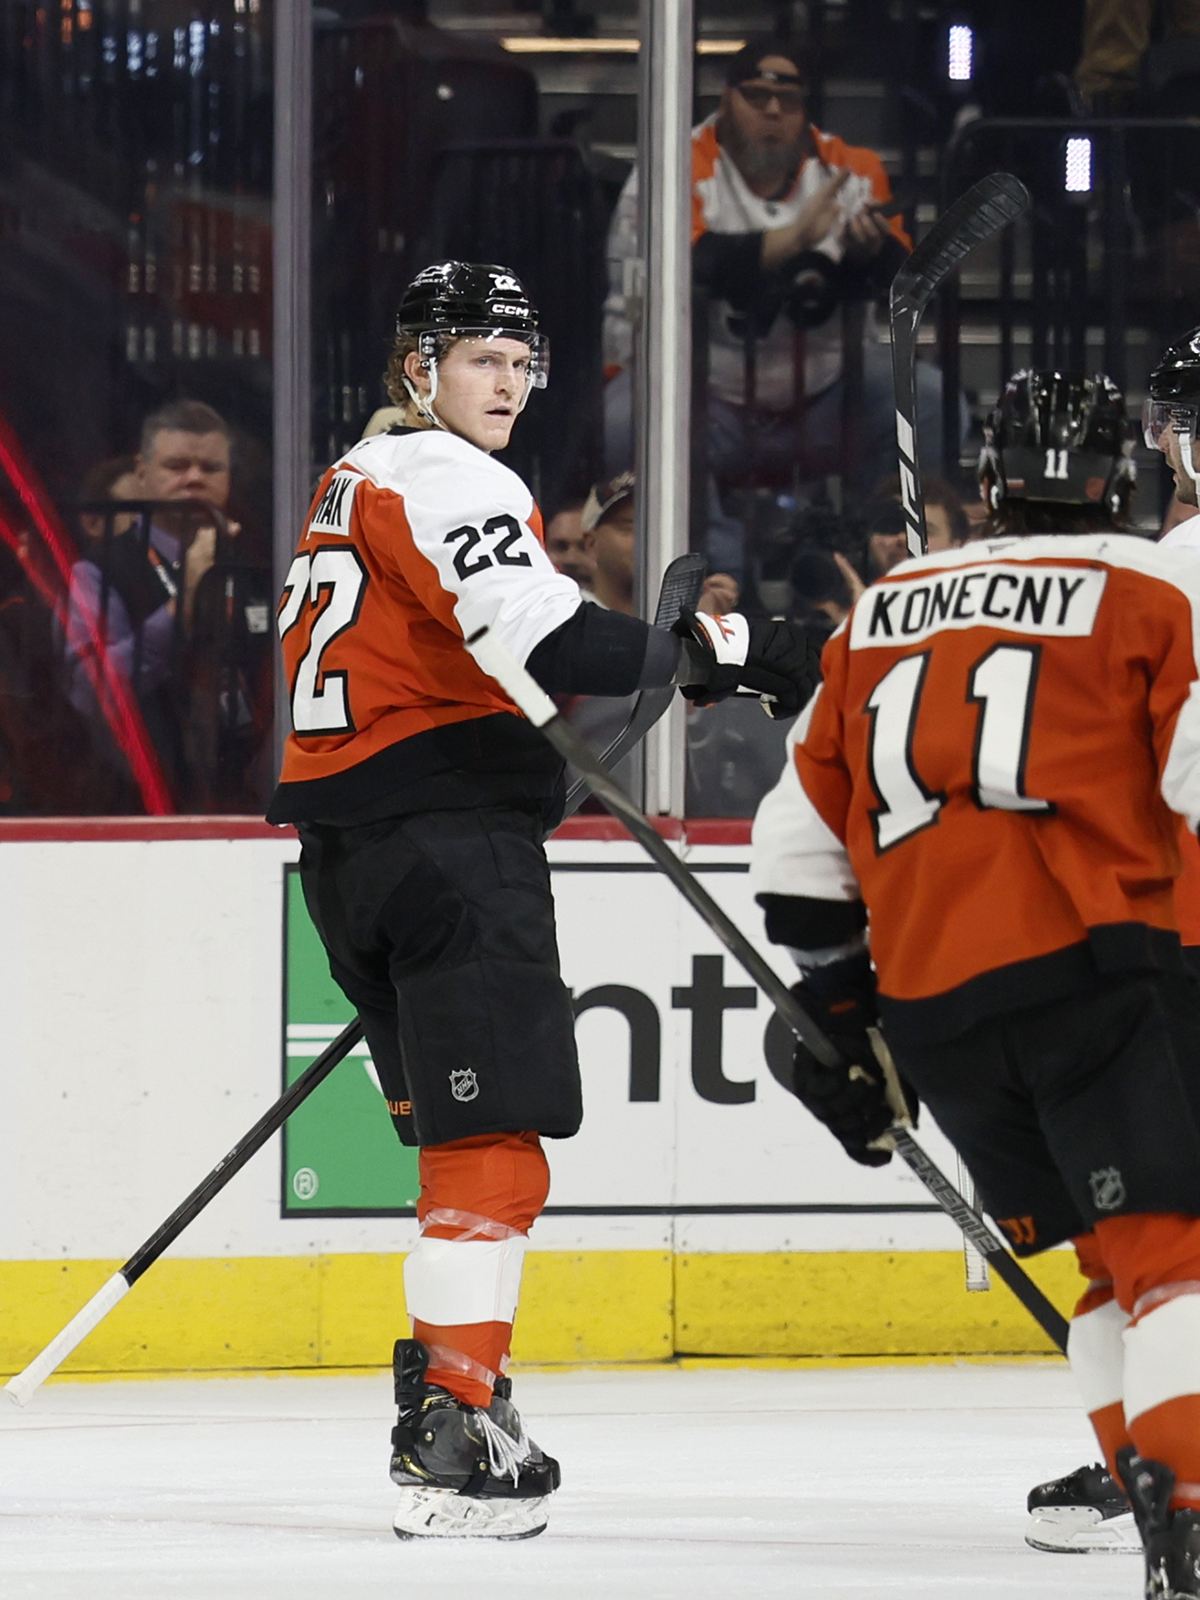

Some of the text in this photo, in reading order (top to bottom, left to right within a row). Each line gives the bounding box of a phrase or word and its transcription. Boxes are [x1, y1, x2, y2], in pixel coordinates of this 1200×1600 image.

[491, 303, 530, 317] CCM
[1043, 448, 1069, 480] 11
[442, 513, 533, 581] 22
[868, 572, 1085, 638] KONECNY
[862, 641, 1058, 858] 11
